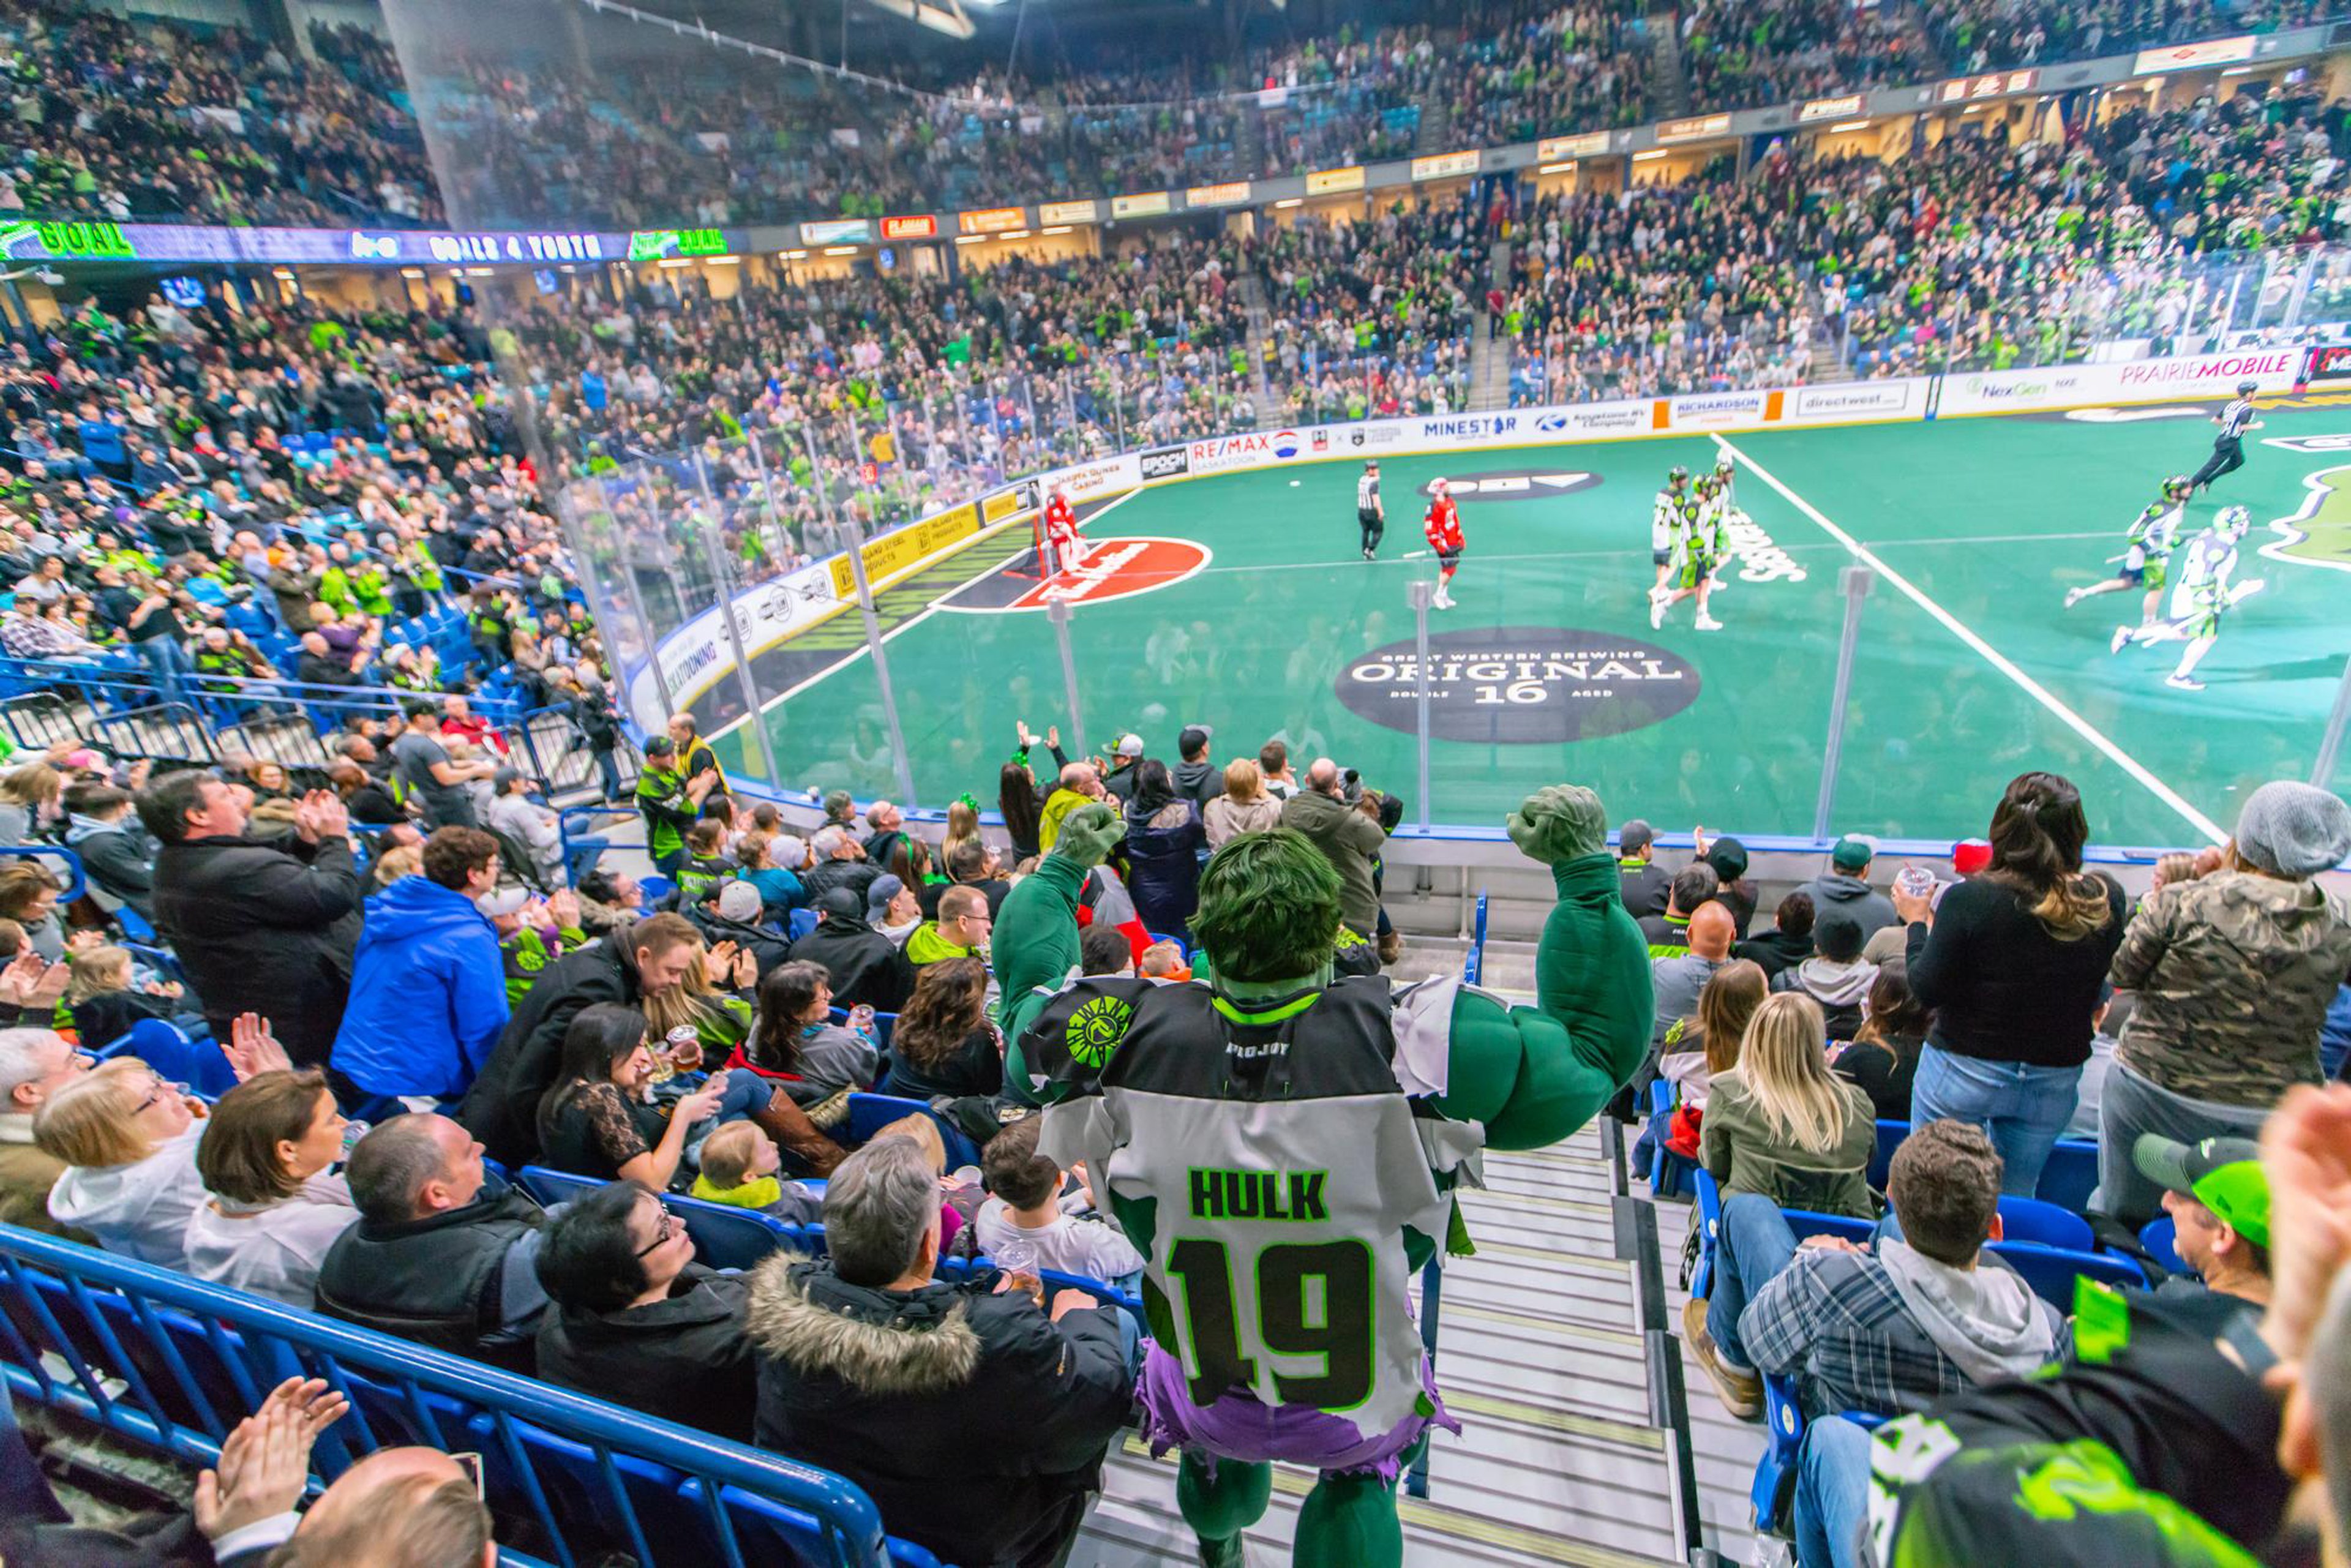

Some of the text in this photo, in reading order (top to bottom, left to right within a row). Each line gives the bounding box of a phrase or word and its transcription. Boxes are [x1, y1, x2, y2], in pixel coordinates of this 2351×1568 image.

[40, 222, 133, 256] GOAL
[2120, 354, 2292, 384] PRAIRIEMOBILE
[1678, 399, 1759, 411] RICHARDSON
[1194, 434, 1270, 460] RE/MAX
[1142, 452, 1185, 473] EPOCH
[1551, 651, 1645, 659] BREWING
[1351, 660, 1682, 683] ORIGINAL
[1474, 680, 1547, 704] 16
[1187, 1166, 1330, 1221] HULK
[1166, 1236, 1375, 1413] 19
